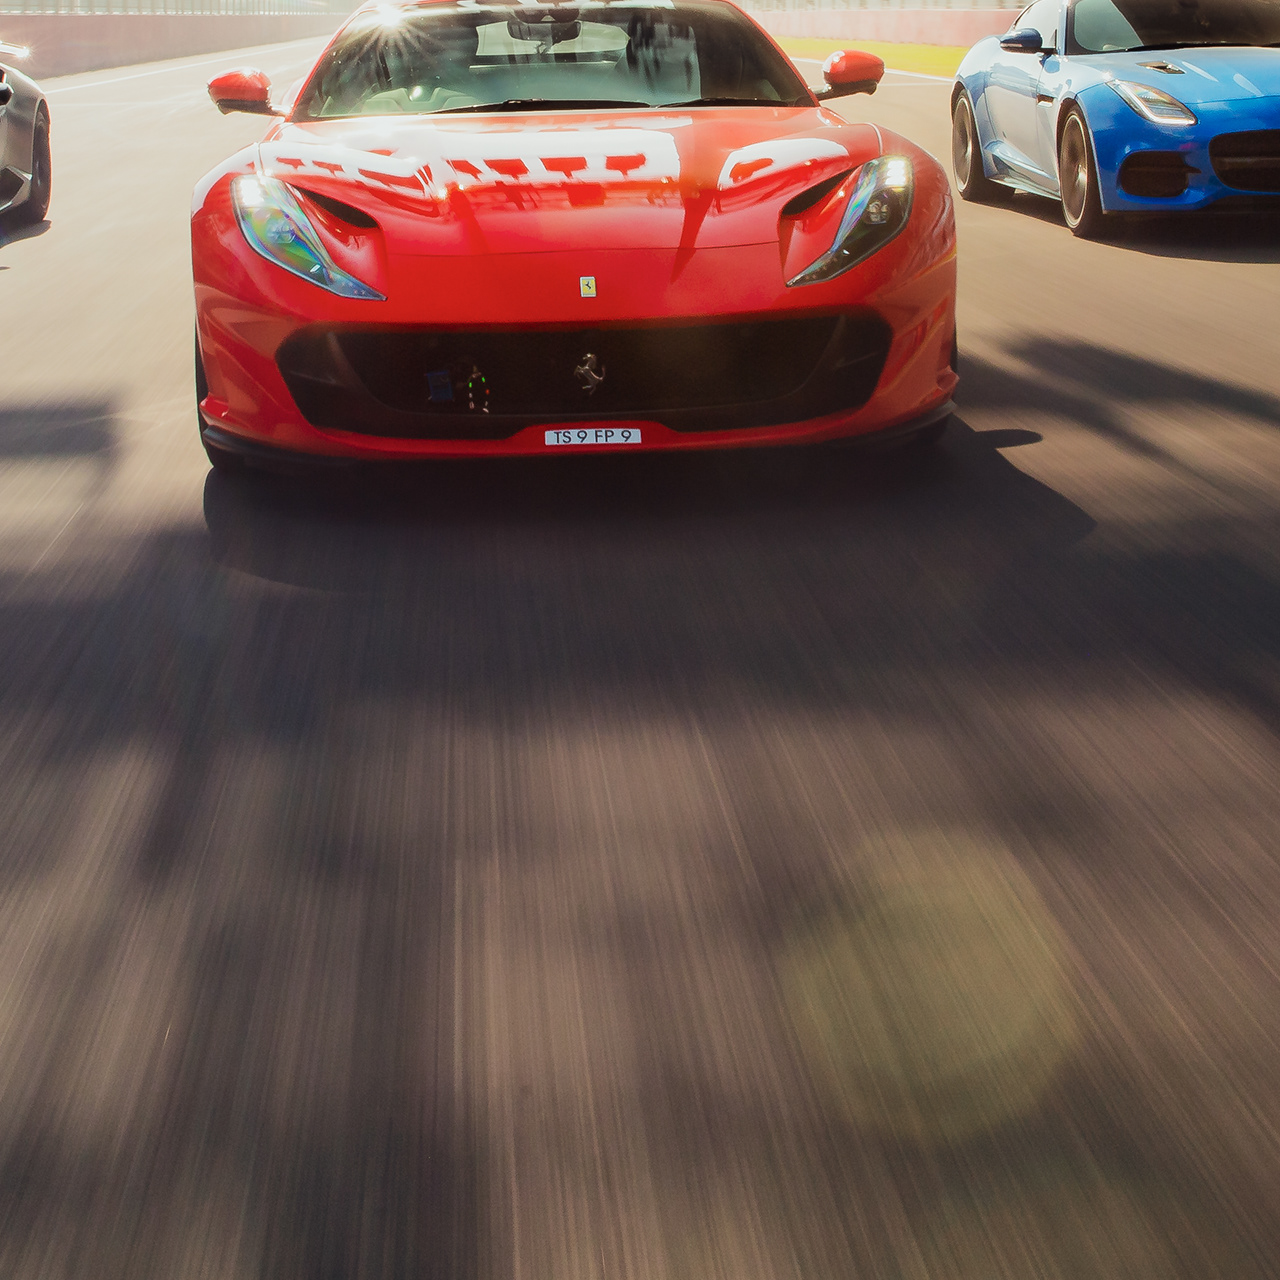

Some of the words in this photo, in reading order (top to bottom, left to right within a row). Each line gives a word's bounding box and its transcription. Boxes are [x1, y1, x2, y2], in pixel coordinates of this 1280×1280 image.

[554, 431, 571, 444] TS
[577, 430, 588, 443] 9
[594, 429, 615, 443] FP
[621, 429, 632, 442] 9
